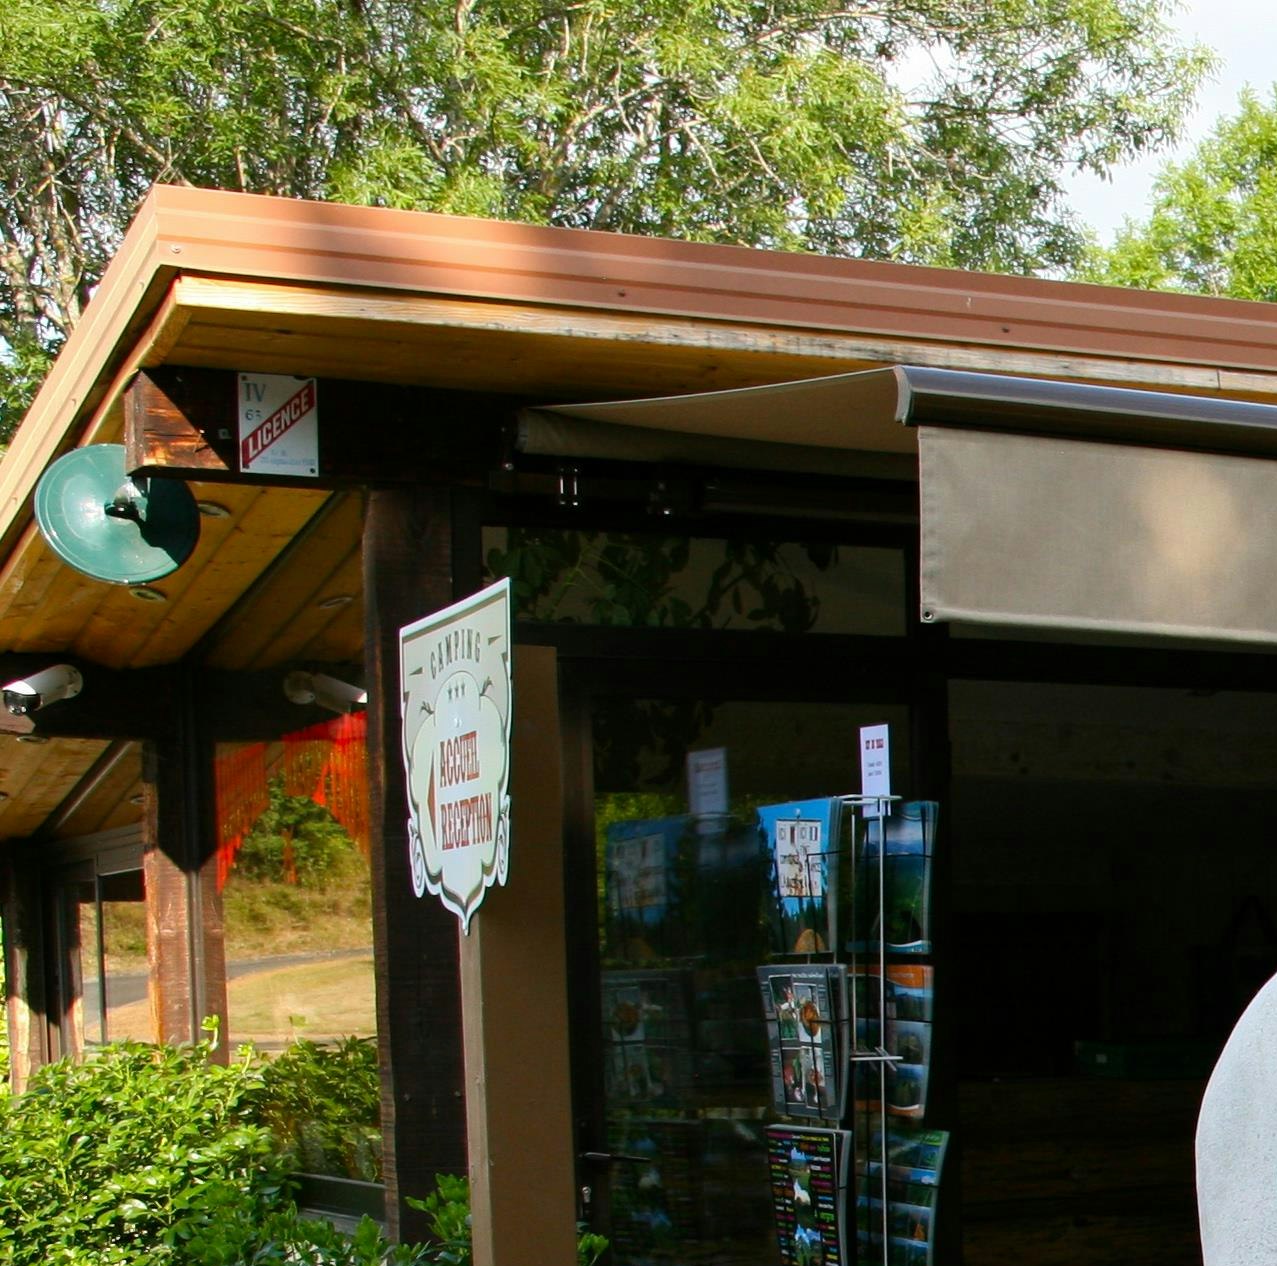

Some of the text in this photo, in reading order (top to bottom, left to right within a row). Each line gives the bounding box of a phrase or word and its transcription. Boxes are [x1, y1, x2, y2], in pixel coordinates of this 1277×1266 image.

[248, 388, 310, 459] LICENCE
[430, 628, 481, 680] CAMPING
[440, 730, 480, 788] ACCUEIL
[441, 792, 493, 851] RECEPTION
